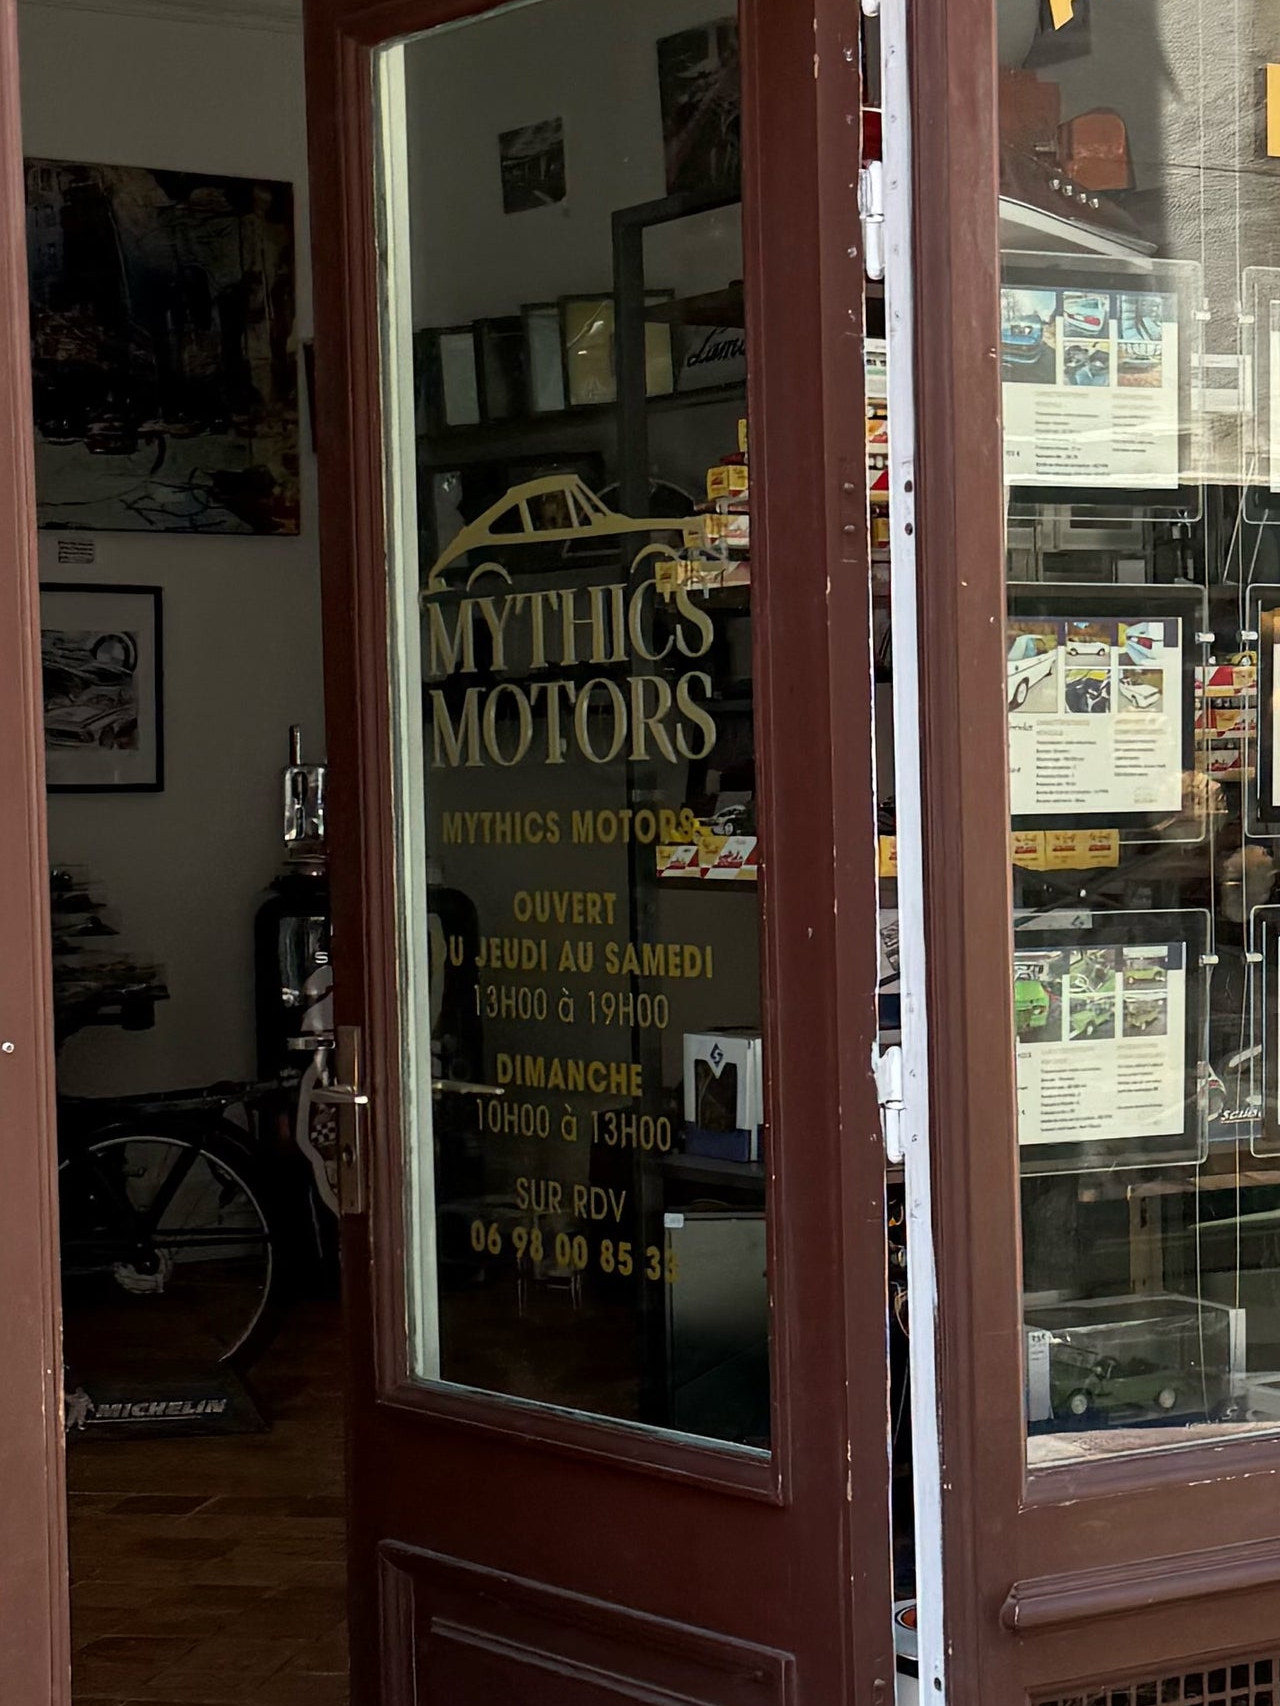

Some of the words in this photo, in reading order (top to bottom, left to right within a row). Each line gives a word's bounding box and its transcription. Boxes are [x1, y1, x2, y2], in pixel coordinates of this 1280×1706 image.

[425, 578, 714, 676] MYTHICS
[430, 671, 717, 768] MOTORS
[442, 810, 562, 845] MYTHICS
[571, 808, 695, 844] MOTORS
[513, 891, 617, 926] OUVERT
[474, 936, 548, 973] JEUDI
[558, 939, 593, 974] AU
[604, 943, 715, 980] SAMEDI
[472, 983, 548, 1021] 13H00
[559, 986, 575, 1023] à
[587, 990, 670, 1030] 19H00
[495, 1053, 644, 1098] DIMANCHE
[476, 1098, 550, 1139] 10H00
[560, 1102, 577, 1142] à
[590, 1110, 672, 1152] 13H00
[515, 1176, 562, 1214] SUR
[572, 1182, 627, 1224] RDV
[471, 1219, 502, 1256] 06
[511, 1224, 544, 1263] 98
[554, 1231, 588, 1270] 00
[599, 1237, 634, 1277] 85
[96, 1398, 227, 1418] MICHELIN
